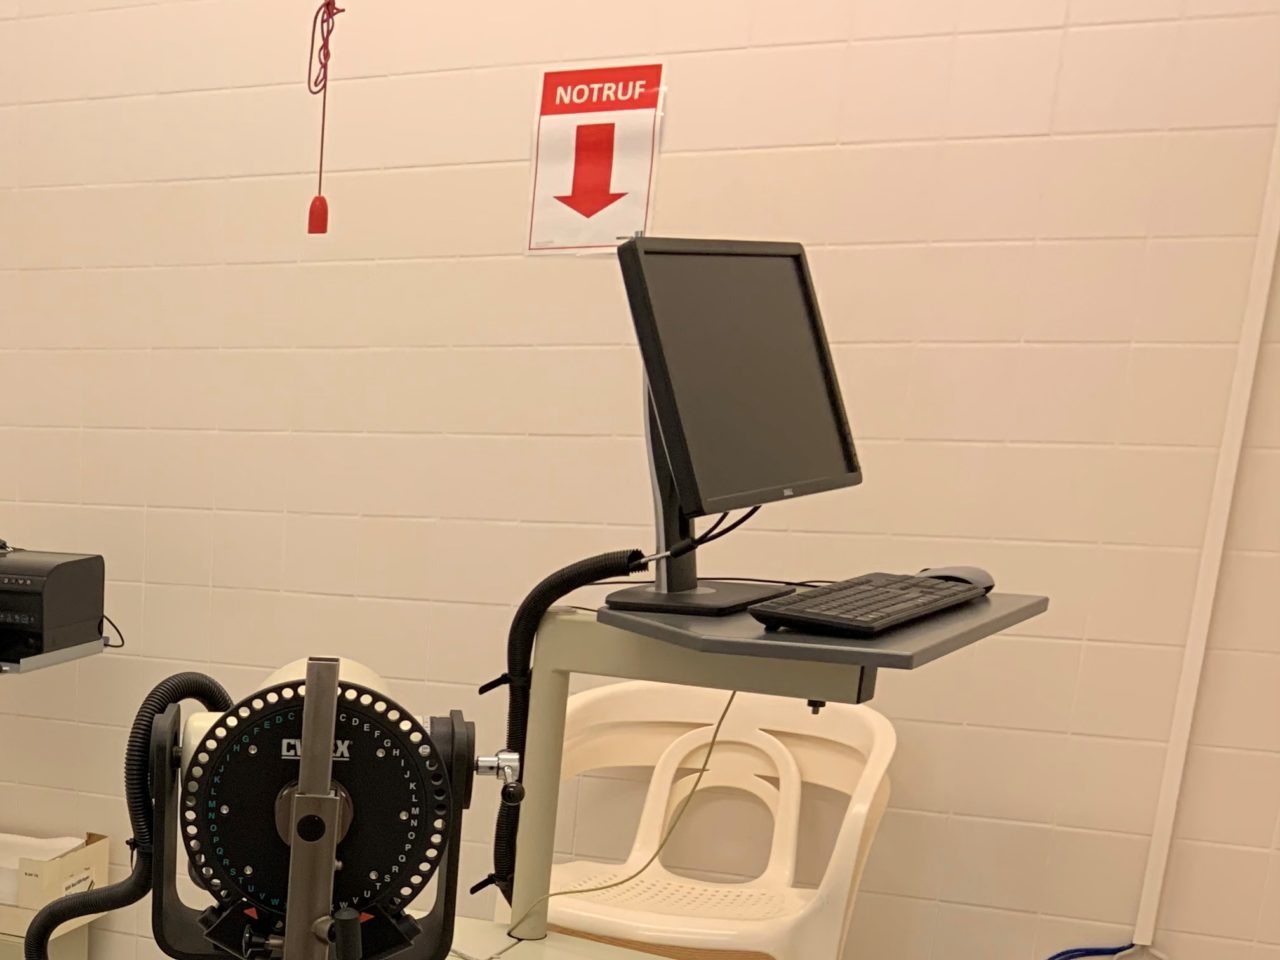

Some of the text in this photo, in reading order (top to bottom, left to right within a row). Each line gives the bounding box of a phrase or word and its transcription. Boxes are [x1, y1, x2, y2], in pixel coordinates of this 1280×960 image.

[555, 80, 647, 105] NOTRUF
[276, 716, 283, 724] D
[288, 712, 295, 720] C
[352, 718, 359, 726] D
[374, 730, 381, 738] F
[384, 739, 391, 747] G
[233, 744, 240, 752] H
[404, 770, 410, 778] J
[409, 782, 417, 790] K
[412, 794, 418, 802] L
[208, 800, 216, 808] M
[411, 807, 419, 815] M
[411, 819, 418, 827] N
[210, 824, 217, 832] O
[408, 832, 416, 840] O
[216, 847, 224, 855] Q
[230, 868, 236, 876] S
[392, 865, 399, 873] R
[238, 876, 244, 884] T
[384, 874, 391, 882] S
[364, 890, 371, 898] U
